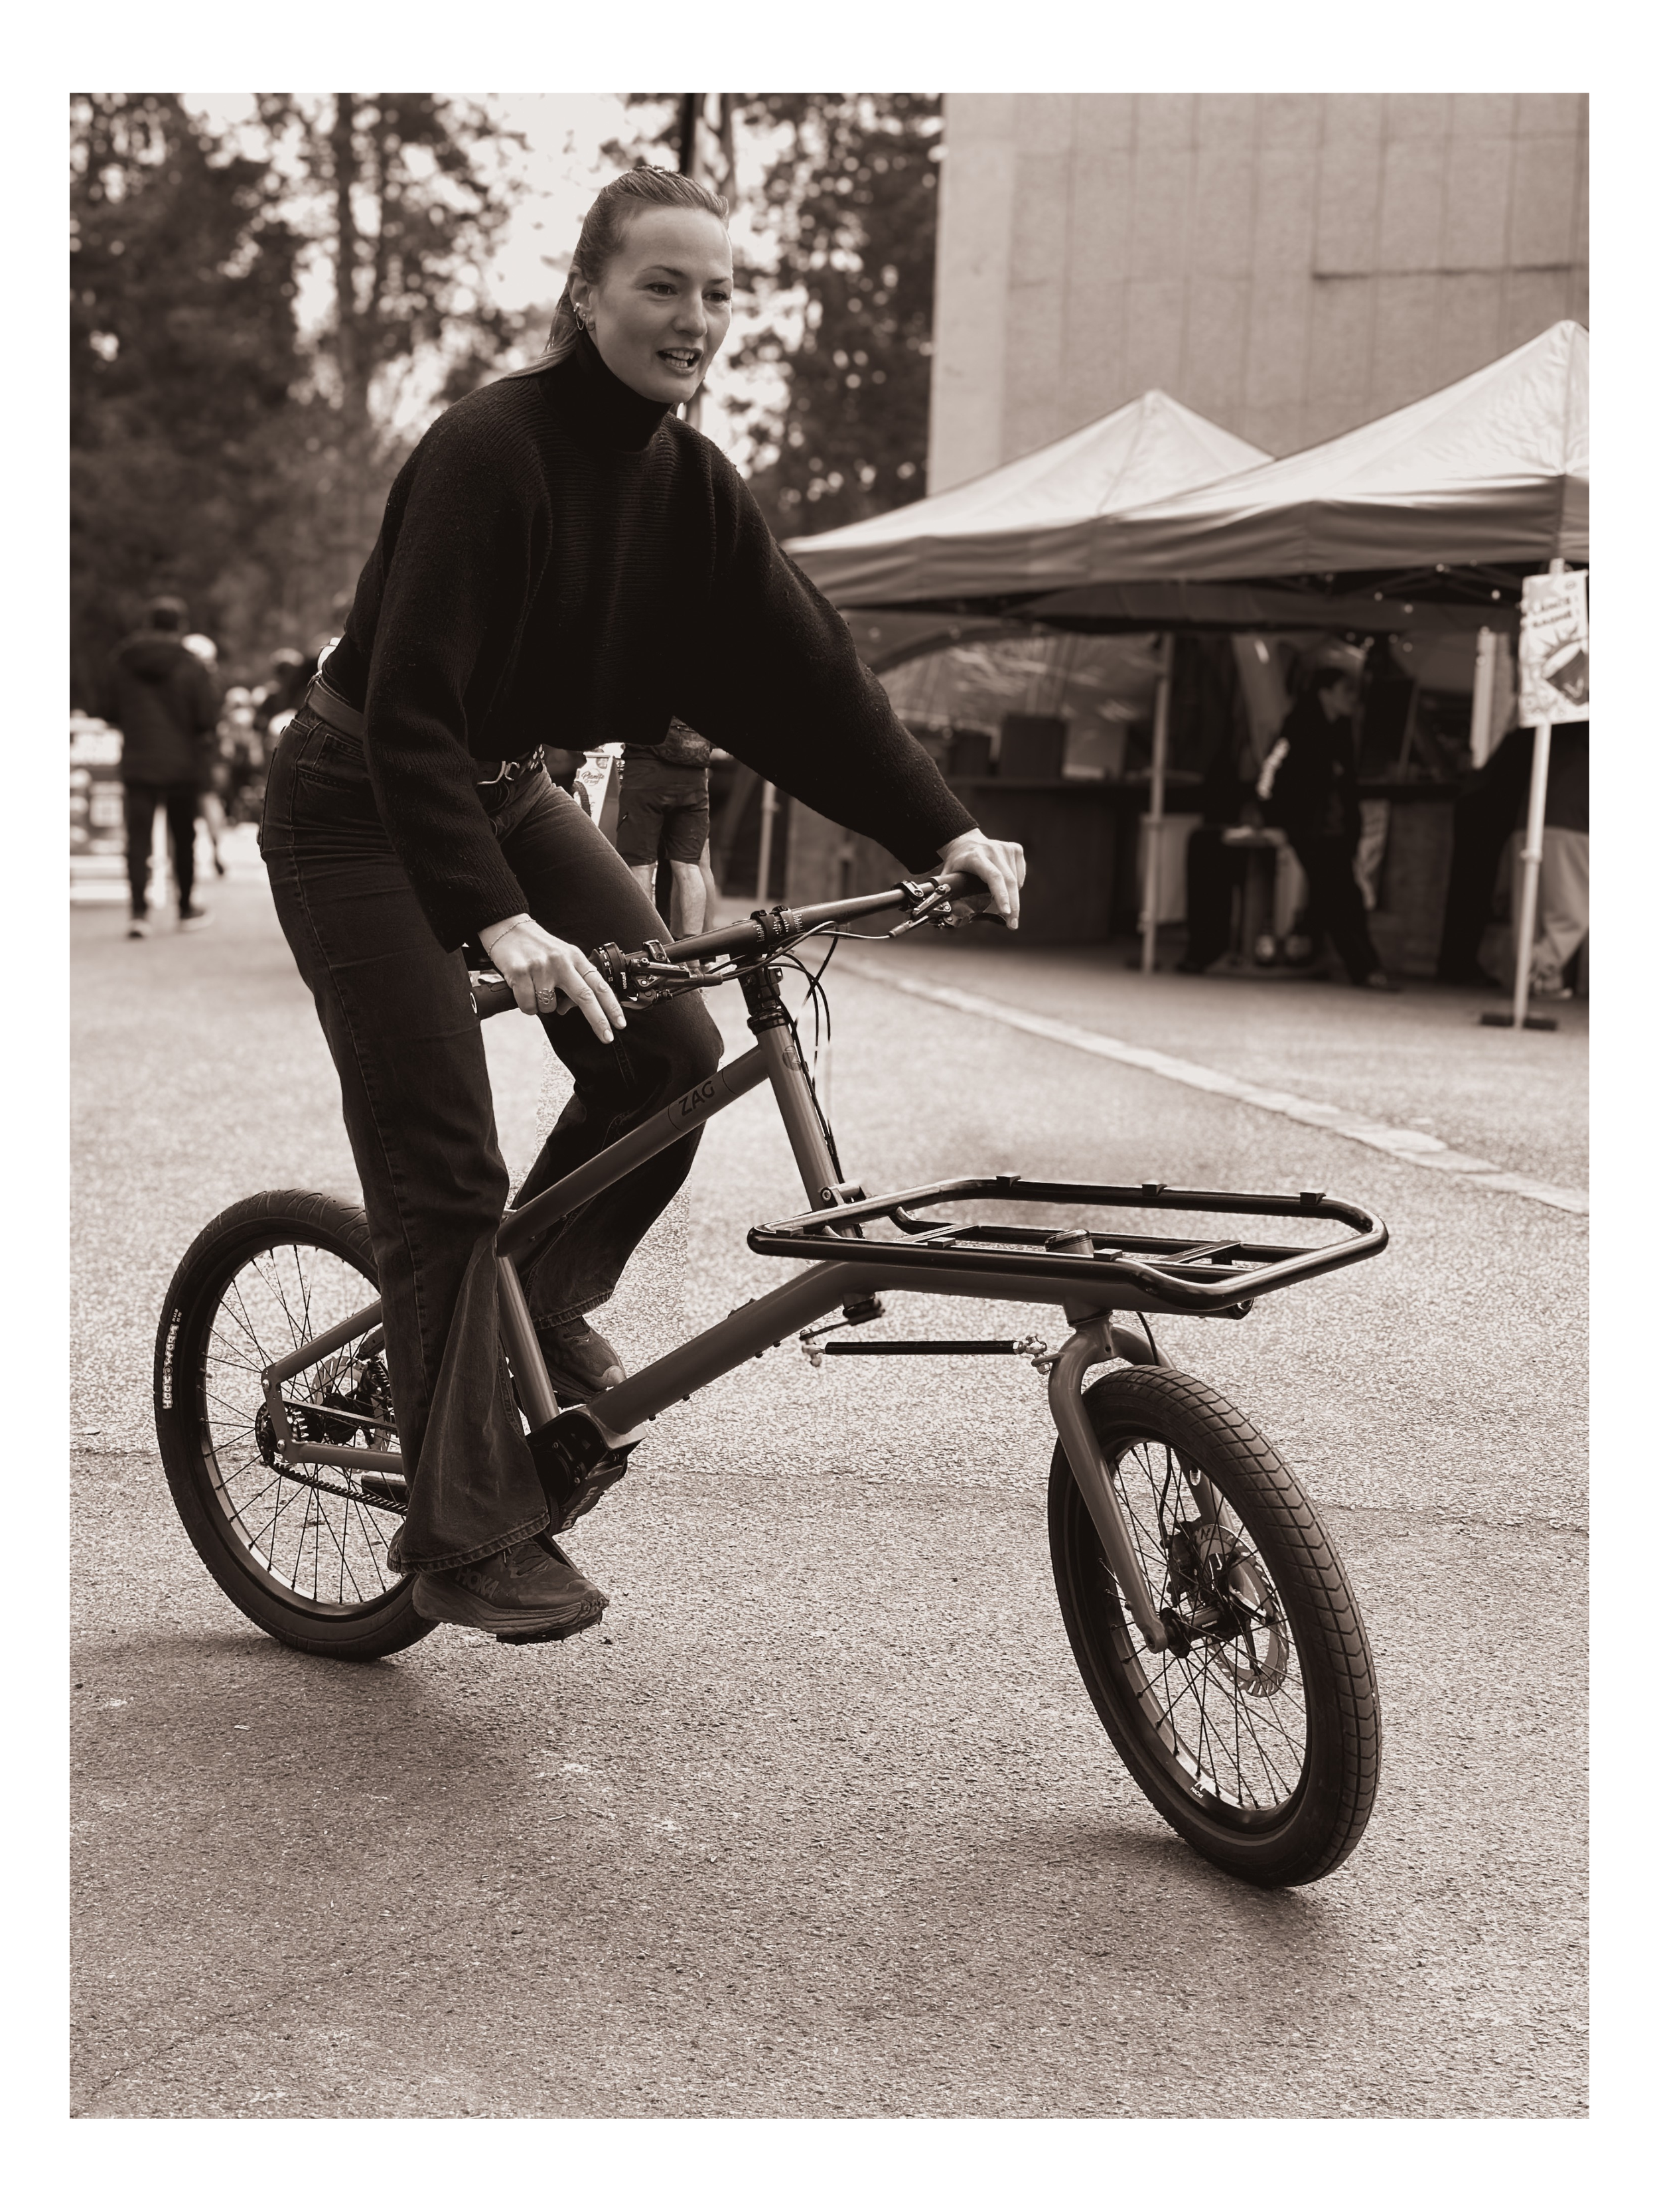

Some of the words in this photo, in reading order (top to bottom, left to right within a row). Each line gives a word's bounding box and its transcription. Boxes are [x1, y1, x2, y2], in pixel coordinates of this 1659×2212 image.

[678, 1080, 715, 1116] ZAG
[561, 1486, 599, 1530] pinion
[455, 1566, 500, 1599] HOKA
